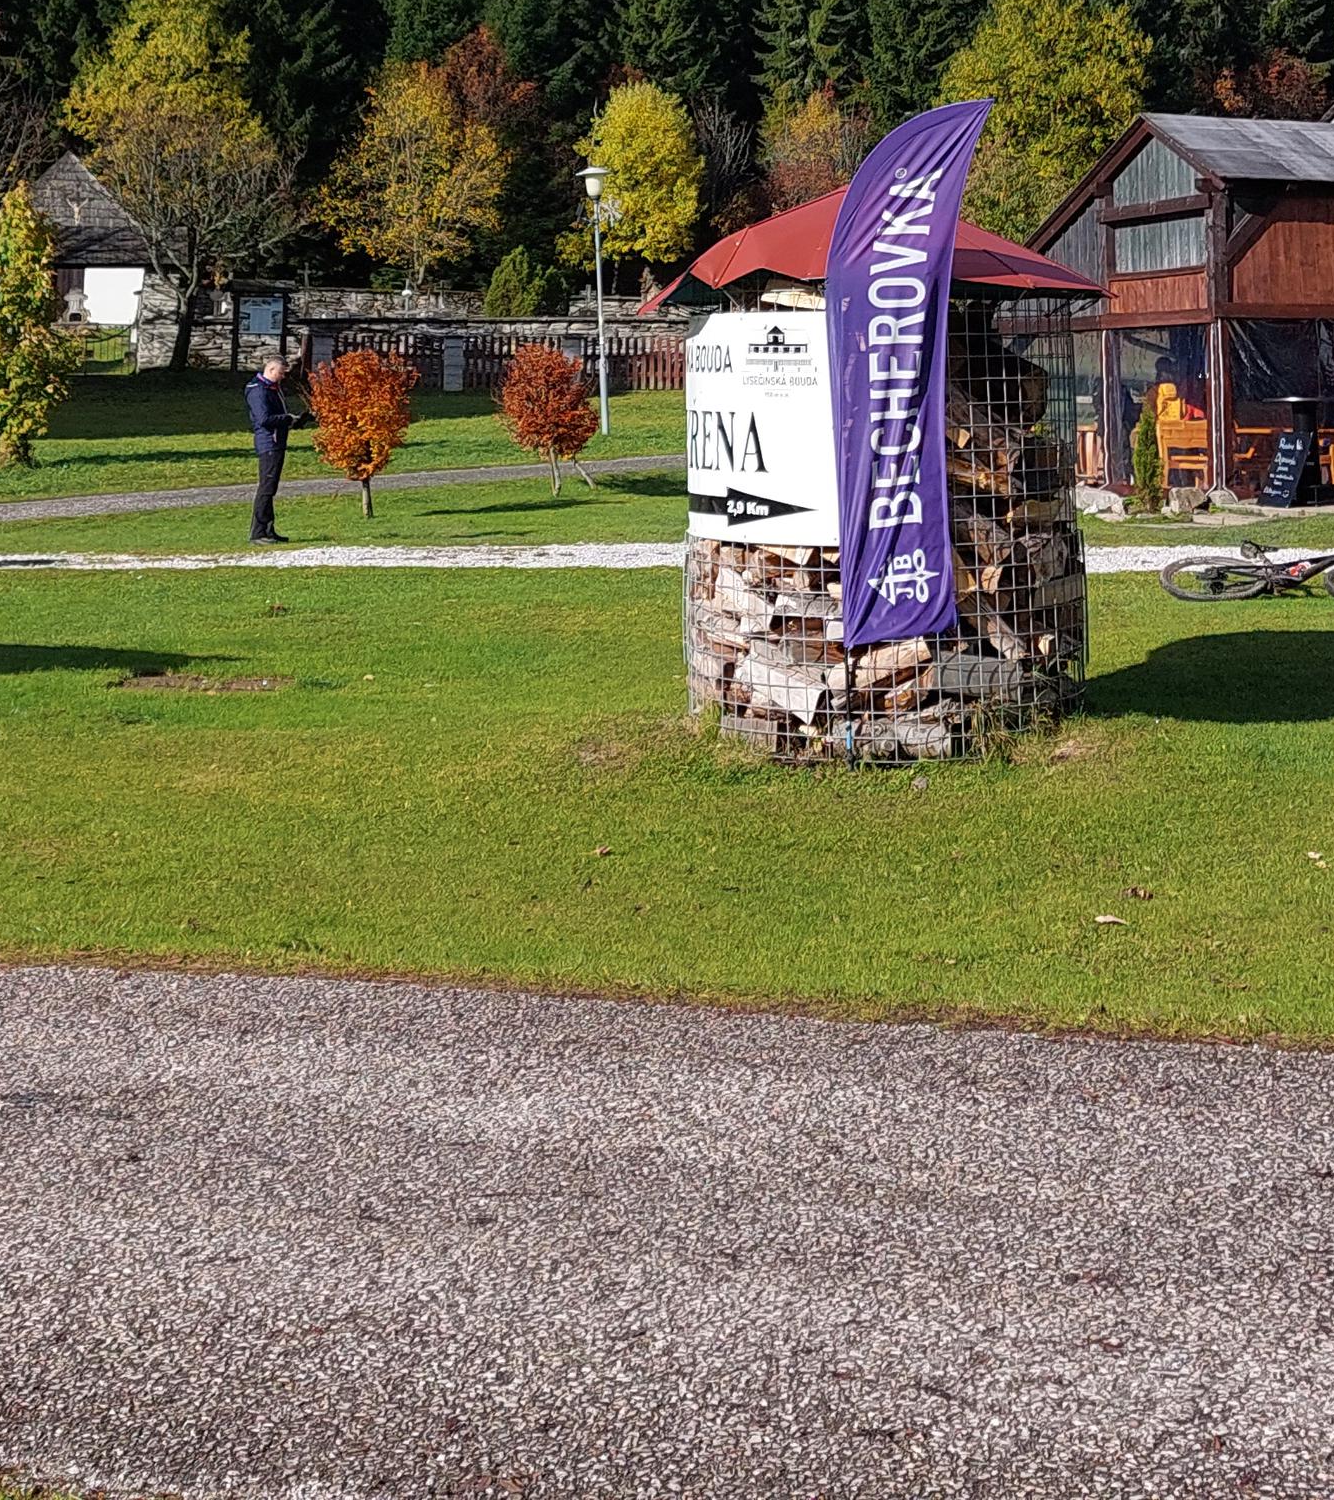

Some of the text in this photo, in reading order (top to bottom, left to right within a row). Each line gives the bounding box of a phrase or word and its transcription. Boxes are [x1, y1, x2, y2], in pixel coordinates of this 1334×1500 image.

[695, 344, 733, 373] BOUDA
[868, 168, 944, 532] BECHEROVKA
[790, 375, 818, 387] BOUDA
[726, 500, 770, 517] 2,9 Km
